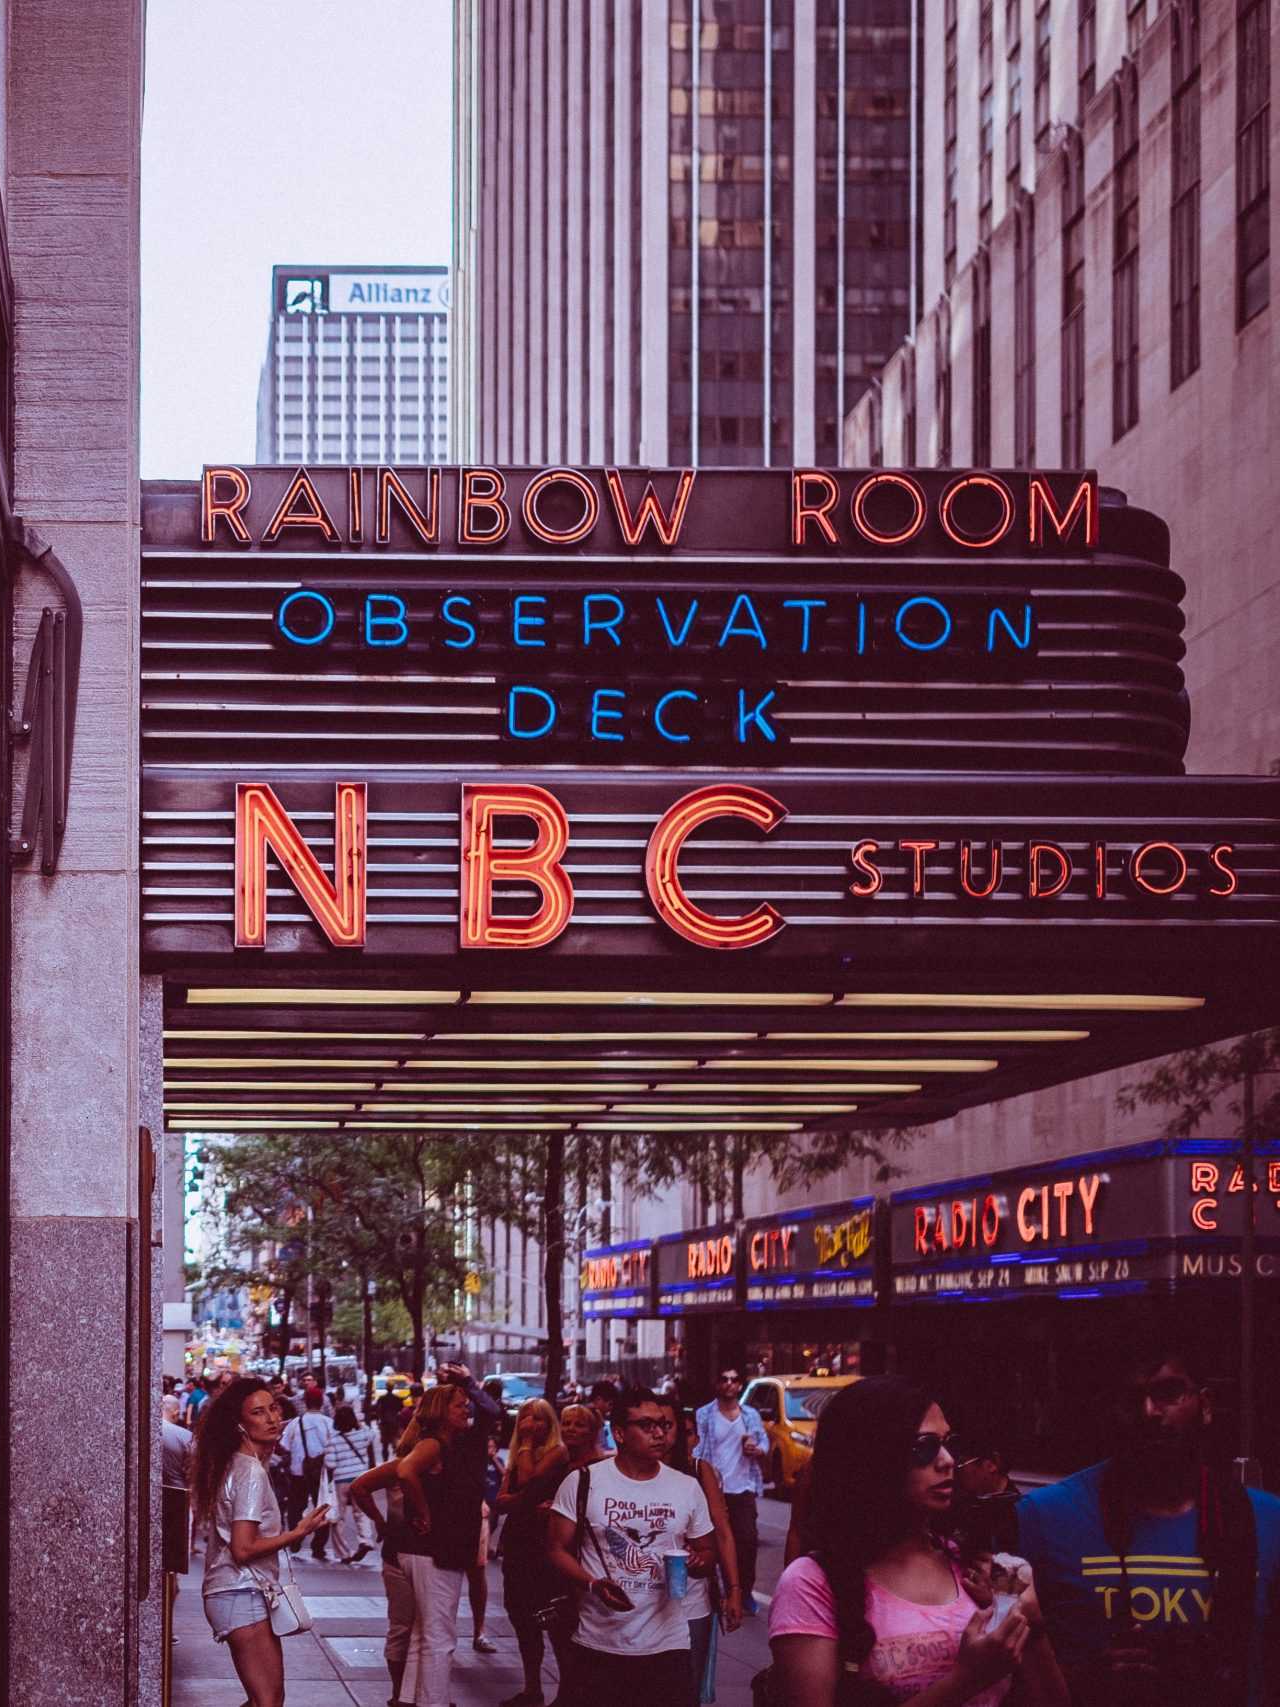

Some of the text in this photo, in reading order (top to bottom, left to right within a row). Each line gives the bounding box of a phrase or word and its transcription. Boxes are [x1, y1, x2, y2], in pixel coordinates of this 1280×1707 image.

[348, 282, 432, 304] Allianz
[202, 466, 1097, 547] RAINBOW ROOM
[277, 591, 1032, 653] OBSERVATION
[508, 687, 777, 743] DECK
[234, 781, 1238, 950] NBC STUDIOS
[914, 1175, 1100, 1255] RADIO CITY
[687, 1229, 794, 1279] RADIO CITY
[1183, 1253, 1273, 1277] MUSC
[604, 1497, 637, 1516] POLO
[607, 1507, 643, 1529] RALPH
[1093, 1586, 1216, 1624] TOKY
